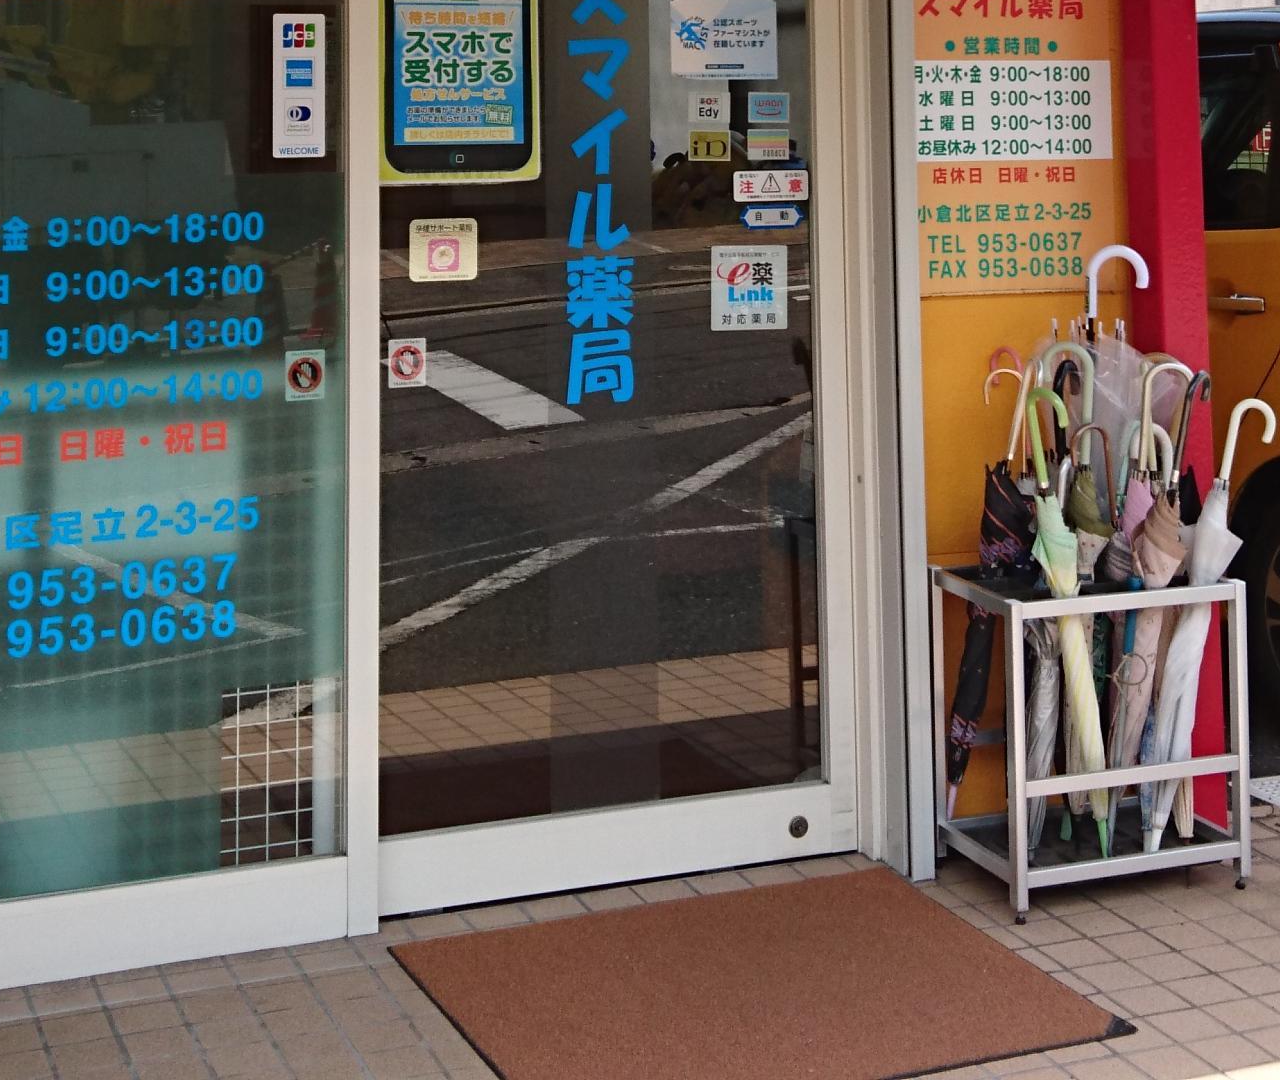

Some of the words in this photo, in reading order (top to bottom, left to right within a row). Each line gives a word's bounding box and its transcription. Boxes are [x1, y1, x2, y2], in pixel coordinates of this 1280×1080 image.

[404, 31, 514, 55] スマホで
[963, 37, 1041, 56] 営業時間
[403, 58, 515, 85] 受付する
[918, 90, 976, 108] 水曜日
[698, 106, 720, 119] Edy
[918, 114, 976, 132] 土曜日
[278, 146, 320, 156] WELCOME
[693, 139, 727, 158] iD
[917, 138, 977, 156] お昼休み
[932, 167, 983, 185] 店休日
[927, 234, 966, 254] TEL
[977, 232, 1083, 253] 953-0637
[928, 260, 967, 280] FAX
[978, 256, 1084, 279] 953-0638
[727, 285, 774, 302] Link
[721, 312, 776, 325] 対応薬局
[7, 552, 237, 610] 953-0637
[6, 599, 237, 659] 953-0638
